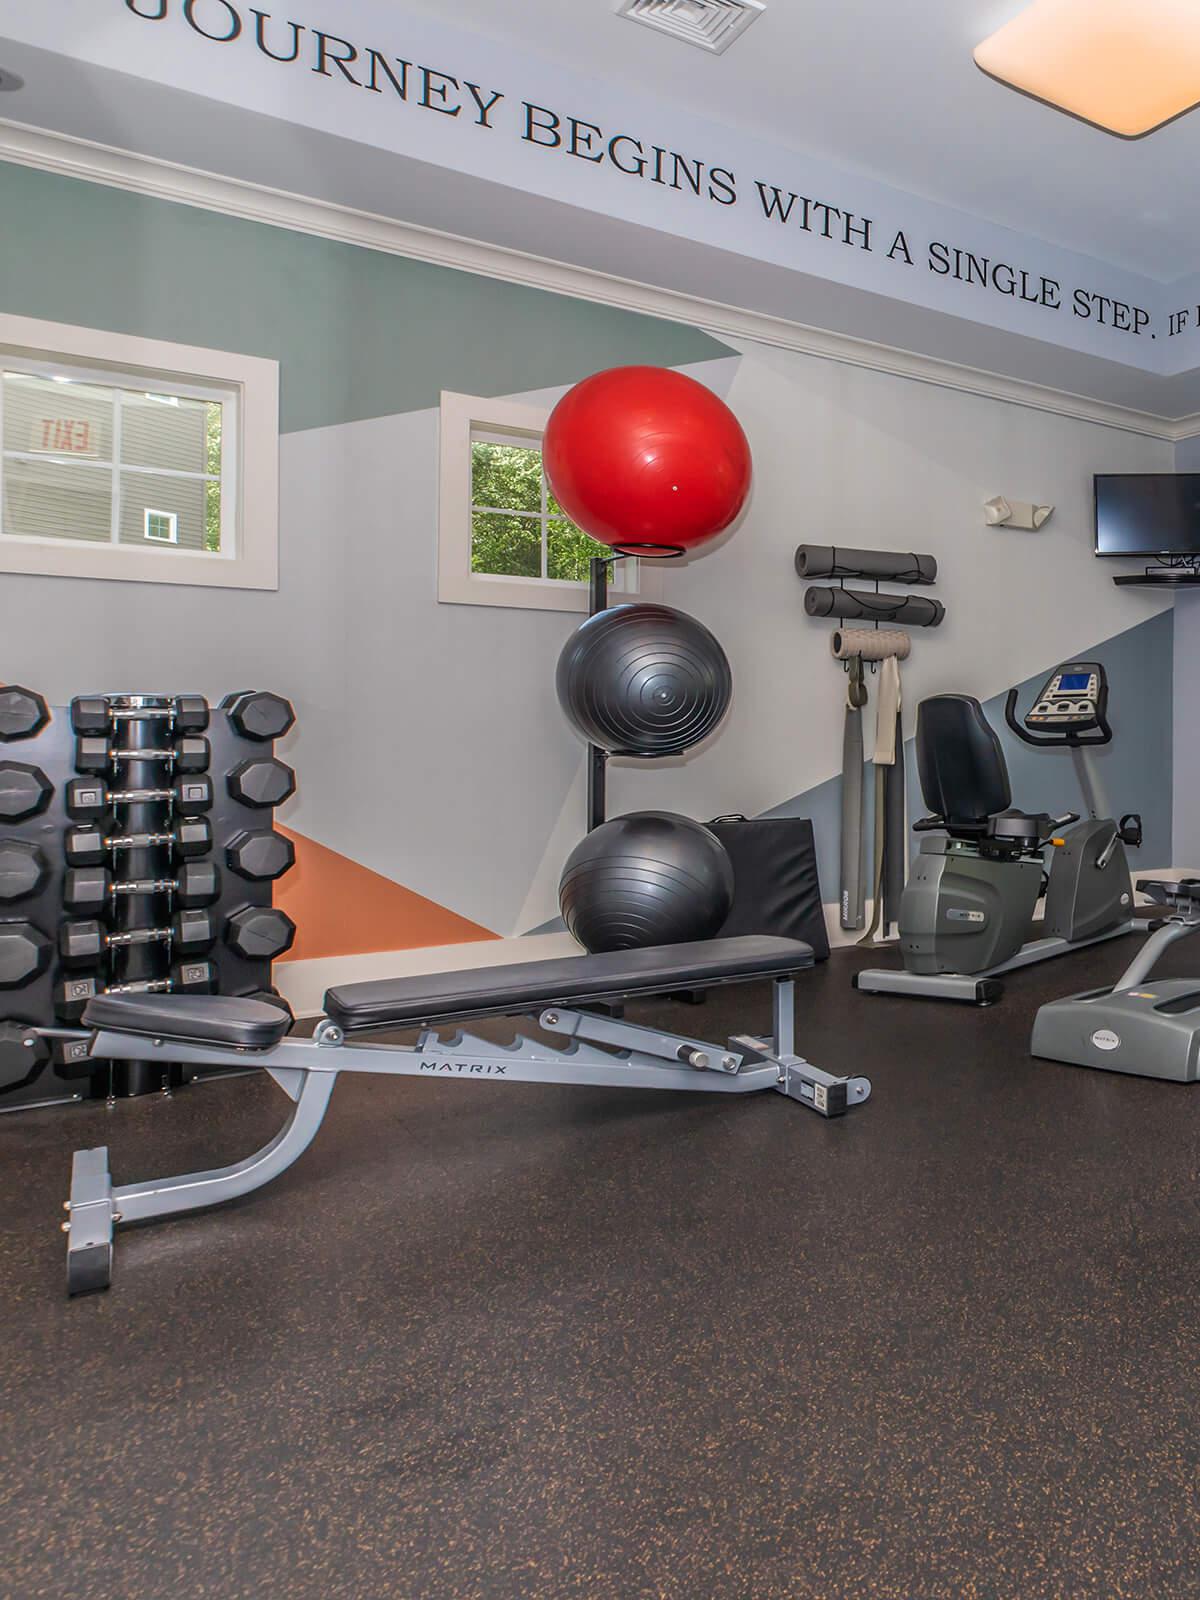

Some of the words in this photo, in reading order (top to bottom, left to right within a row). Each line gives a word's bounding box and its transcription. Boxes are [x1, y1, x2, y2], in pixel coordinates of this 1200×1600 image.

[520, 100, 737, 206] BEGINS
[753, 180, 873, 252] WITH
[885, 230, 915, 266] A
[928, 241, 1061, 310] SINGLE
[1072, 288, 1156, 340] STEP.
[1168, 309, 1190, 337] IF
[420, 1061, 507, 1074] MATRIX
